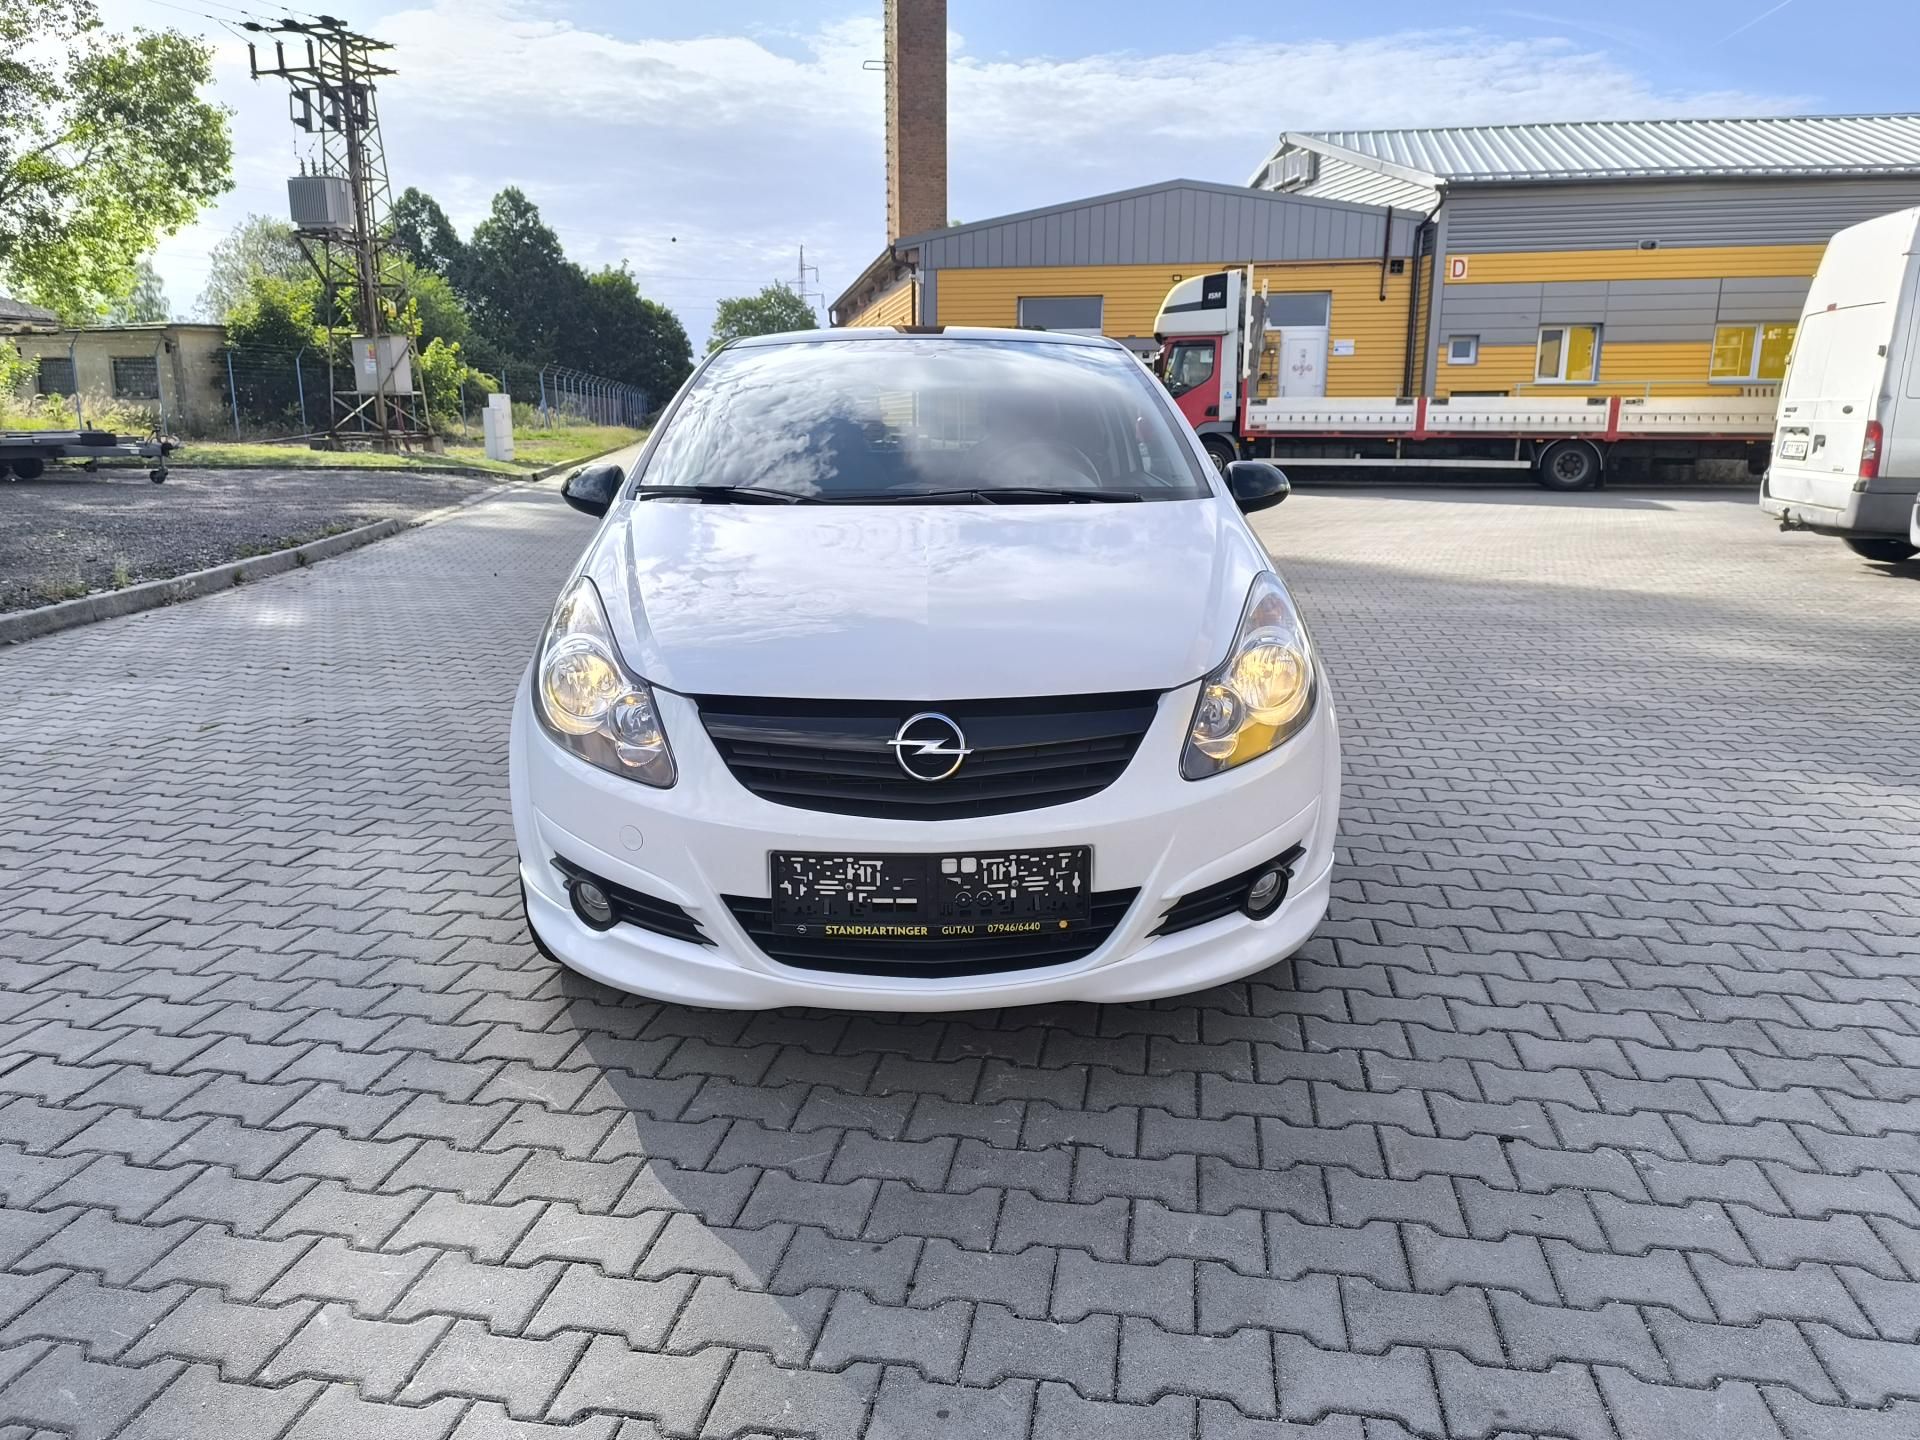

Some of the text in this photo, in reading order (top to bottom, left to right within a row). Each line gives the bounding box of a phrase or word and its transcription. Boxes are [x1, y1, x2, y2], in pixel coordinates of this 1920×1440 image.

[1453, 259, 1466, 278] D
[825, 921, 1041, 936] STANDHARTINGER GUTAU 07946/6440
